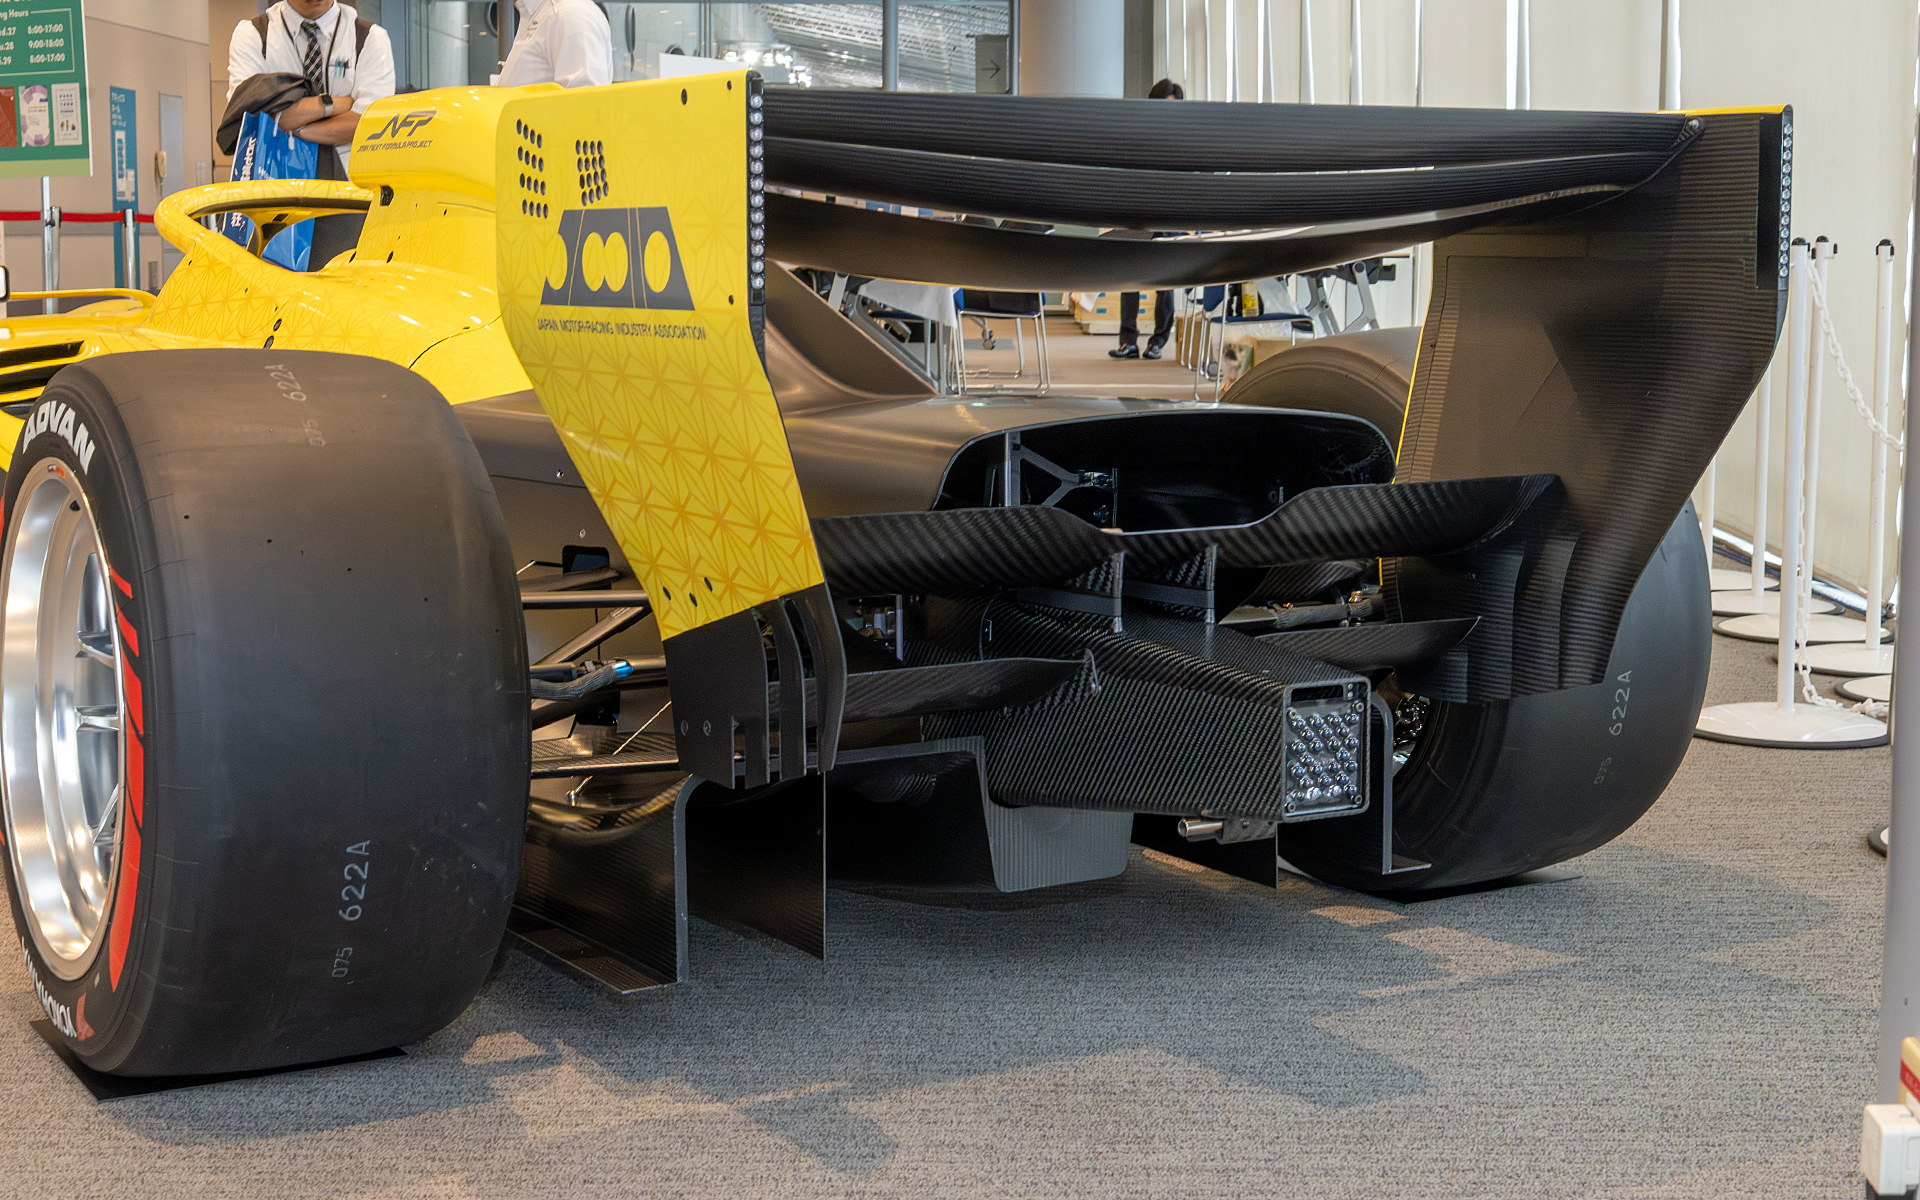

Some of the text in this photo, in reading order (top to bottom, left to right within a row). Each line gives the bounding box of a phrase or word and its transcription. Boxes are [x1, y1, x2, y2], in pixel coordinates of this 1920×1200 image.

[9, 9, 29, 18] Hours
[27, 23, 63, 35] 8:00-17:00
[28, 38, 65, 49] 9:00-18:00
[29, 53, 65, 63] 8:00-17:00
[366, 110, 437, 141] NFP
[537, 318, 707, 341] JAPAN MOTOR-RACING INDUSTRY ASSOCIATION
[264, 364, 307, 402] 622A
[22, 400, 96, 477] ADVAN
[1609, 670, 1632, 736] 622A
[338, 839, 371, 921] 622A
